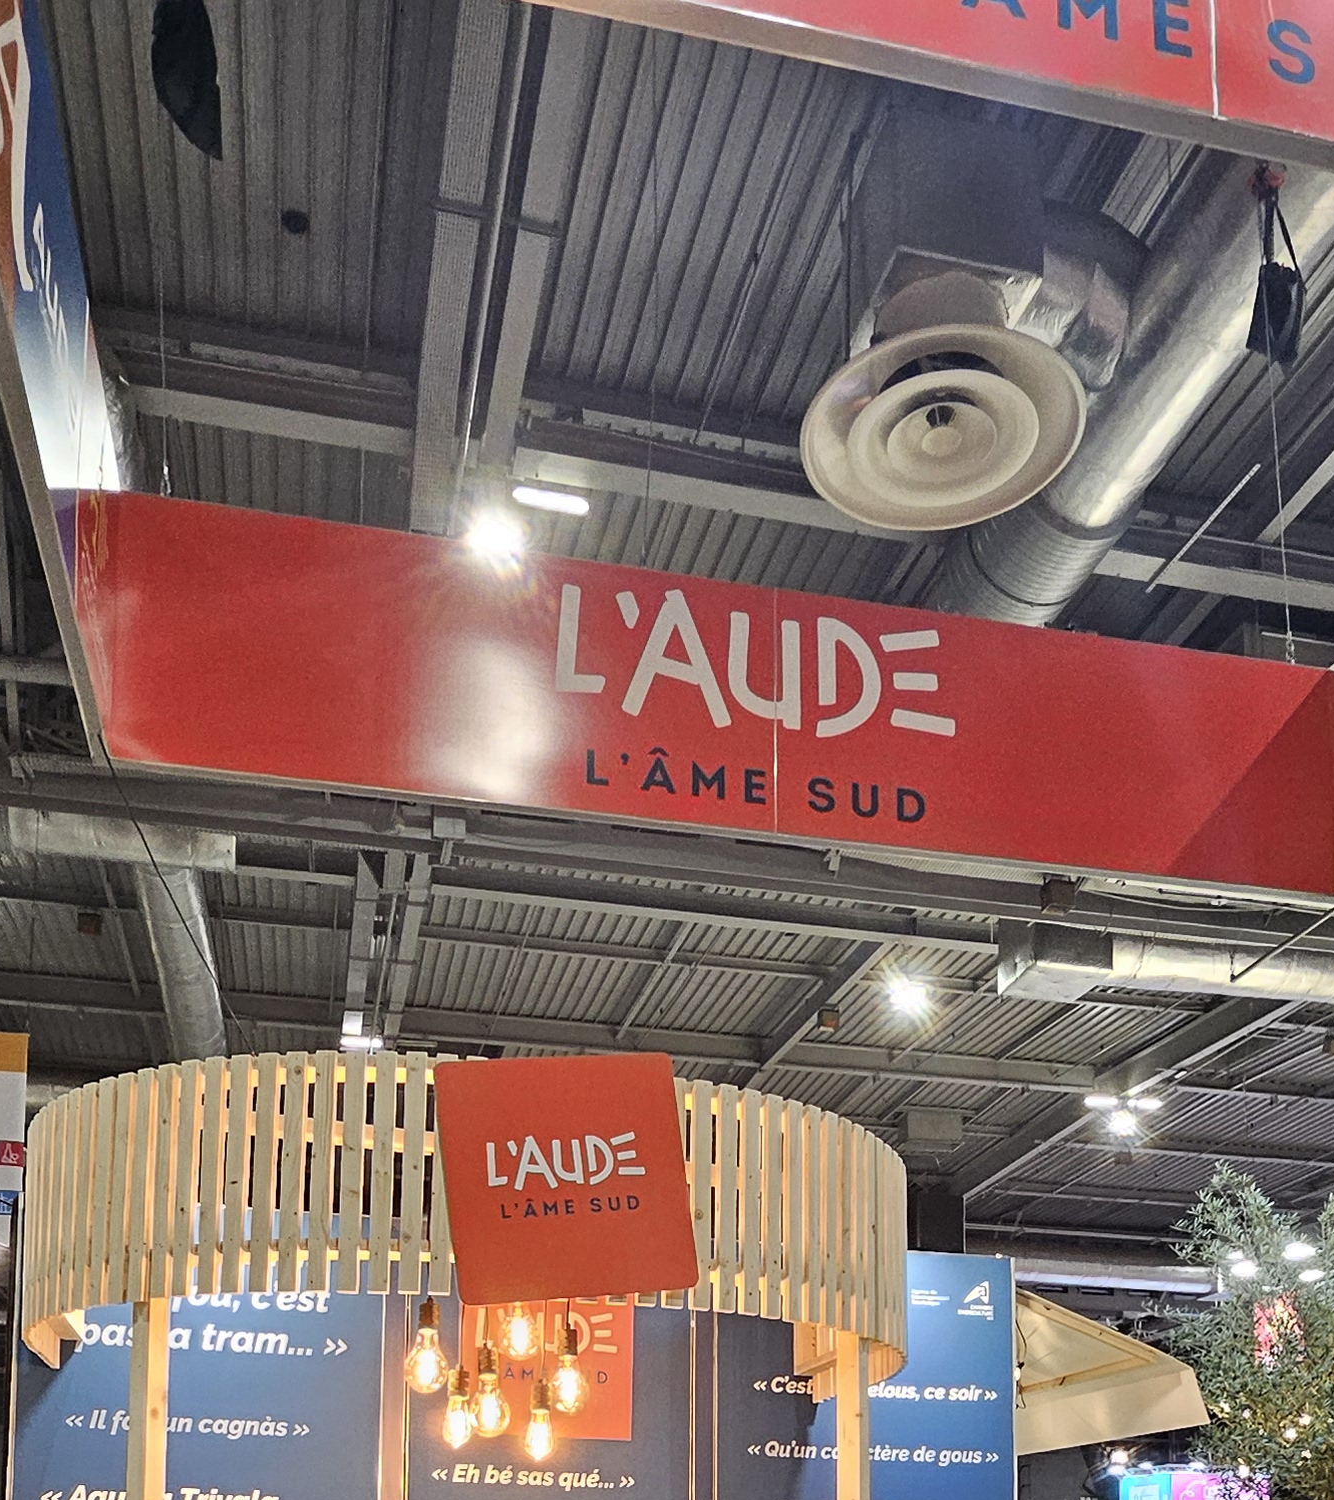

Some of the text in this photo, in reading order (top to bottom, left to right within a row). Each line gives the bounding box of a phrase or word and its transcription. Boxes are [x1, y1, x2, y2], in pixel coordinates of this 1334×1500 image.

[555, 583, 956, 738] L'AUDE
[586, 746, 926, 823] L'ÂME SUD
[486, 1131, 646, 1191] L'AUDE
[500, 1195, 641, 1219] L'ÂME SUD
[923, 1385, 945, 1400] ce
[948, 1383, 983, 1402] soir
[198, 1415, 288, 1441] cagnàs
[764, 1440, 817, 1459] Qu'un
[912, 1445, 936, 1463] de
[938, 1449, 983, 1467] gous
[451, 1463, 479, 1484] Eh
[484, 1464, 513, 1485] bé
[516, 1470, 555, 1487] sas
